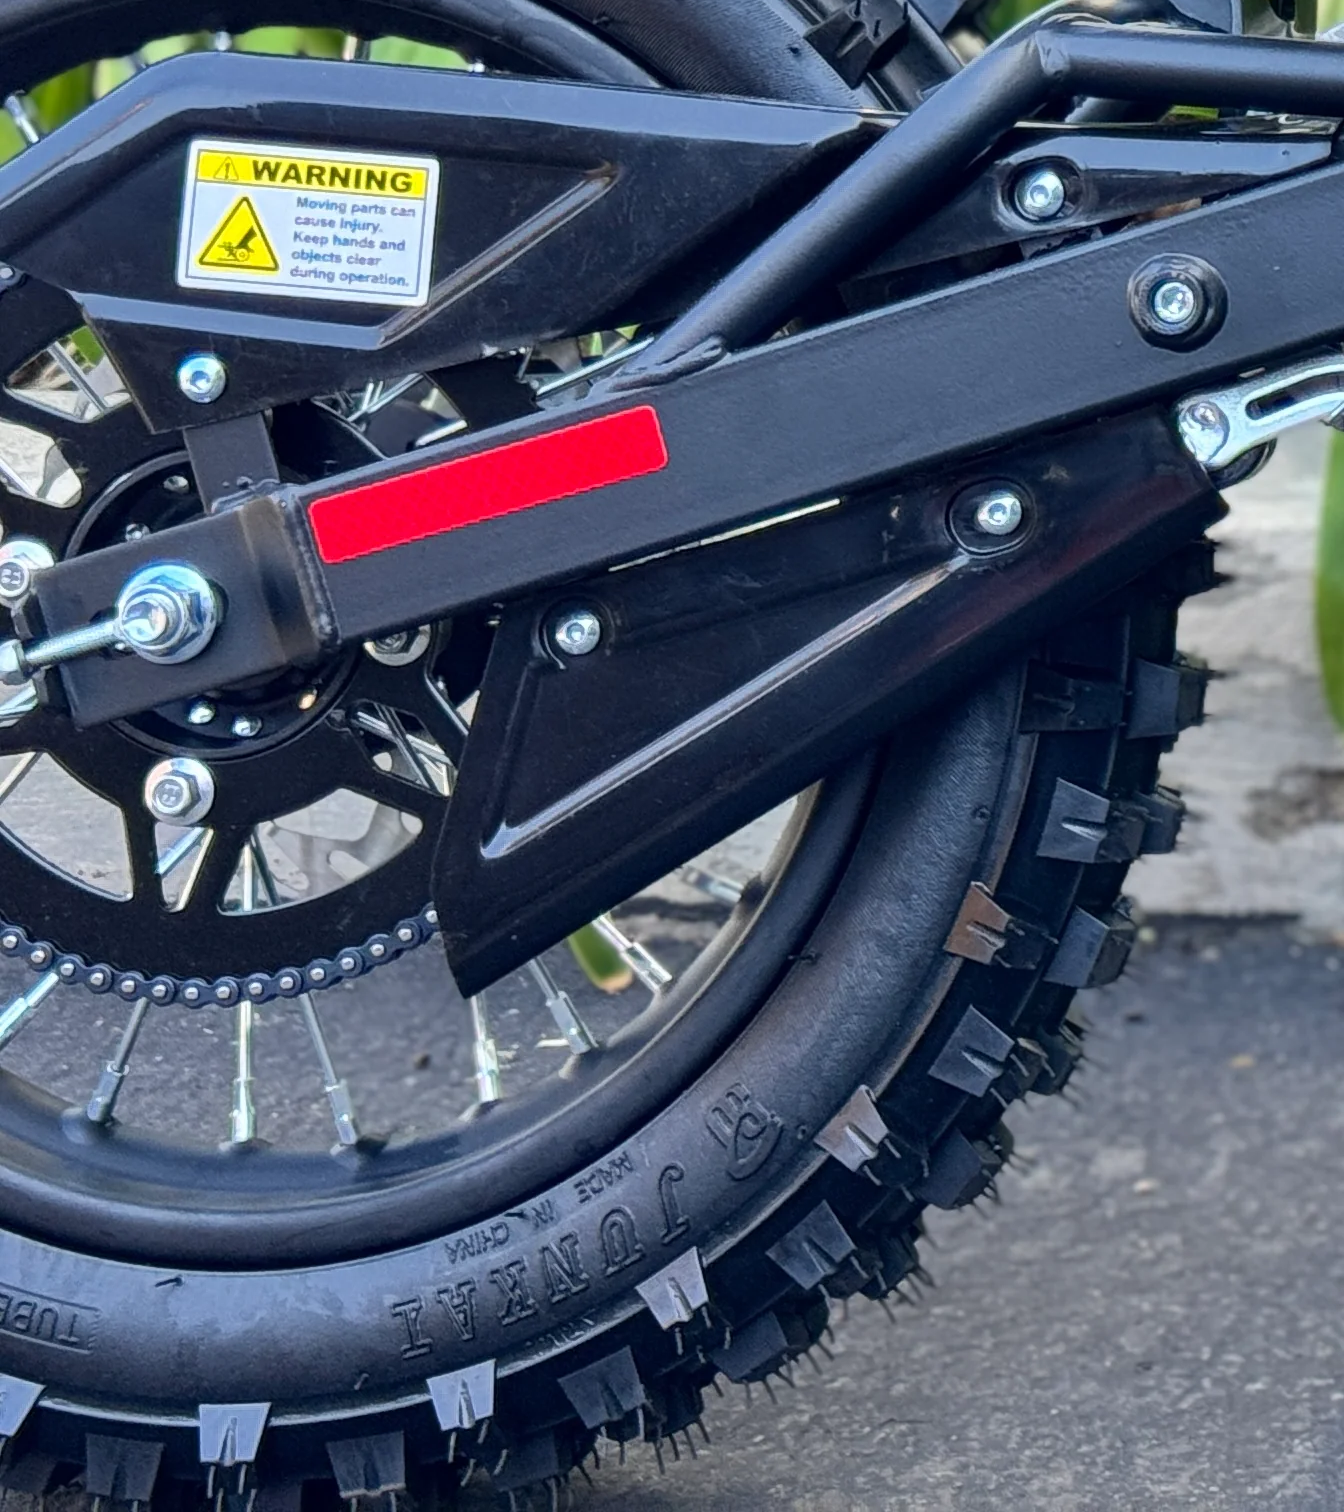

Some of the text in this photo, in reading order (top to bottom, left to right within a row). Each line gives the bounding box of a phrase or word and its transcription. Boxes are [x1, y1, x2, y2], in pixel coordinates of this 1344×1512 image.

[252, 159, 414, 194] WARNING
[296, 196, 416, 218] Moving parts can
[294, 216, 336, 228] cause
[293, 230, 406, 252] Keep hands and
[291, 248, 382, 266] objects clear
[290, 266, 409, 287] during operation.
[445, 1149, 636, 1265] MADE IN CHINA
[391, 1161, 691, 1359] JUNKAI
